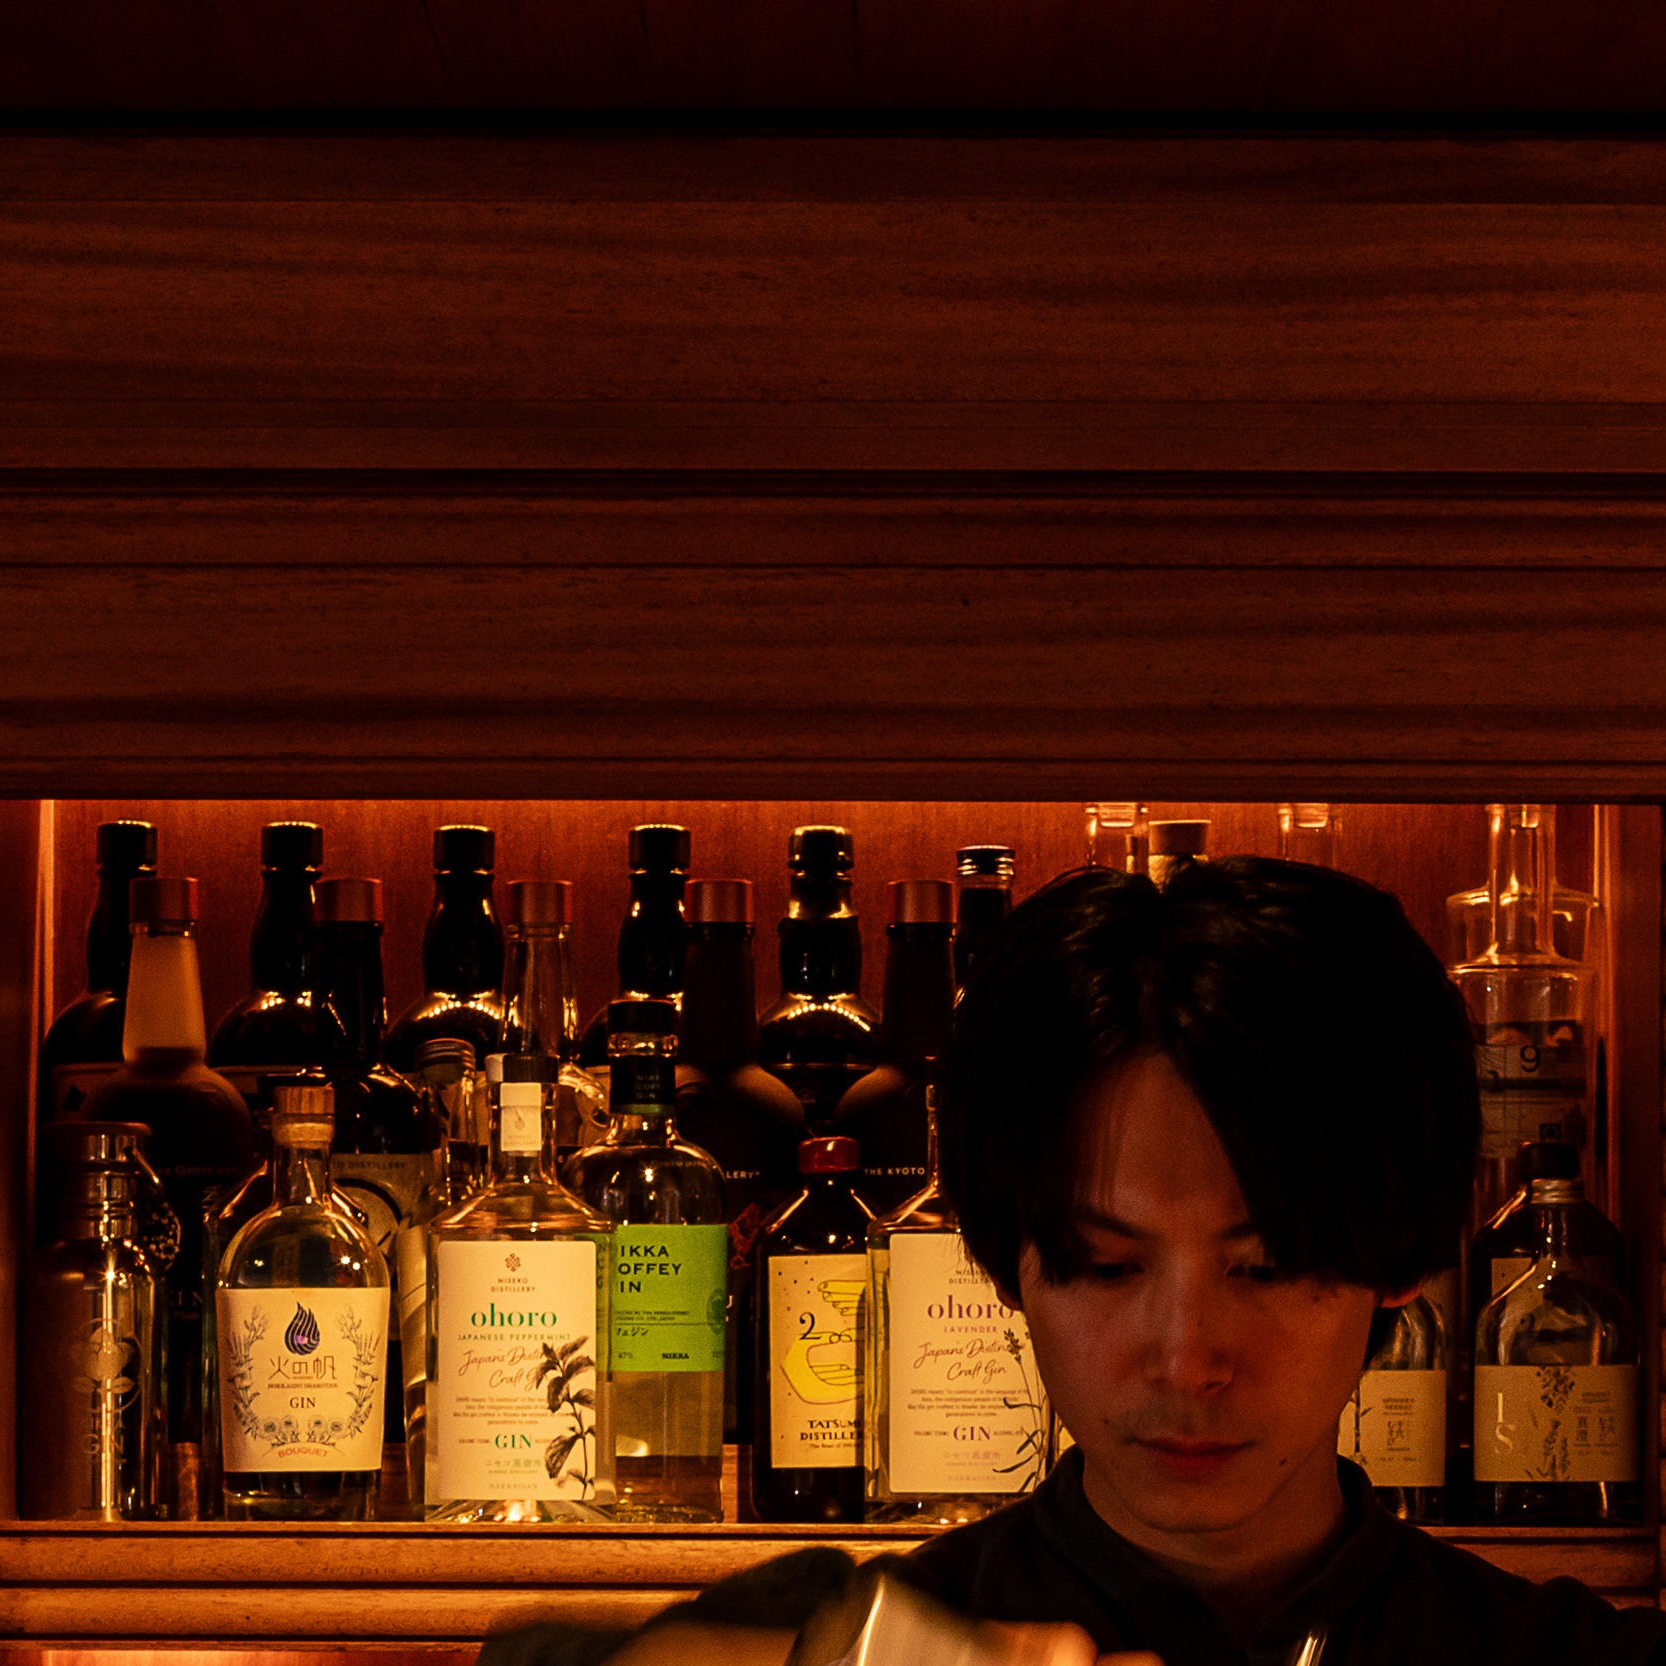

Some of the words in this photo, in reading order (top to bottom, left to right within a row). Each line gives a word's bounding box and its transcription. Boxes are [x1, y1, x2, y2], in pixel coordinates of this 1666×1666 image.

[863, 1167, 883, 1177] THE
[886, 1166, 926, 1177] KYOTO
[620, 1245, 670, 1258] IKKA
[618, 1262, 682, 1276] OFFEY
[490, 1285, 536, 1293] DISTILLERY
[620, 1281, 642, 1294] IN
[927, 1294, 1015, 1320] ohoro
[470, 1302, 558, 1328] ohoro
[799, 1311, 822, 1341] 2
[943, 1325, 998, 1333] LAVENDER
[457, 1333, 504, 1341] JAPANESE
[509, 1333, 571, 1341] PEPPERMINT
[268, 1354, 338, 1381] 火の帆
[289, 1396, 316, 1409] GIN
[952, 1425, 991, 1442] GIN
[494, 1433, 532, 1449] GIN
[277, 1446, 330, 1459] BOUQUET
